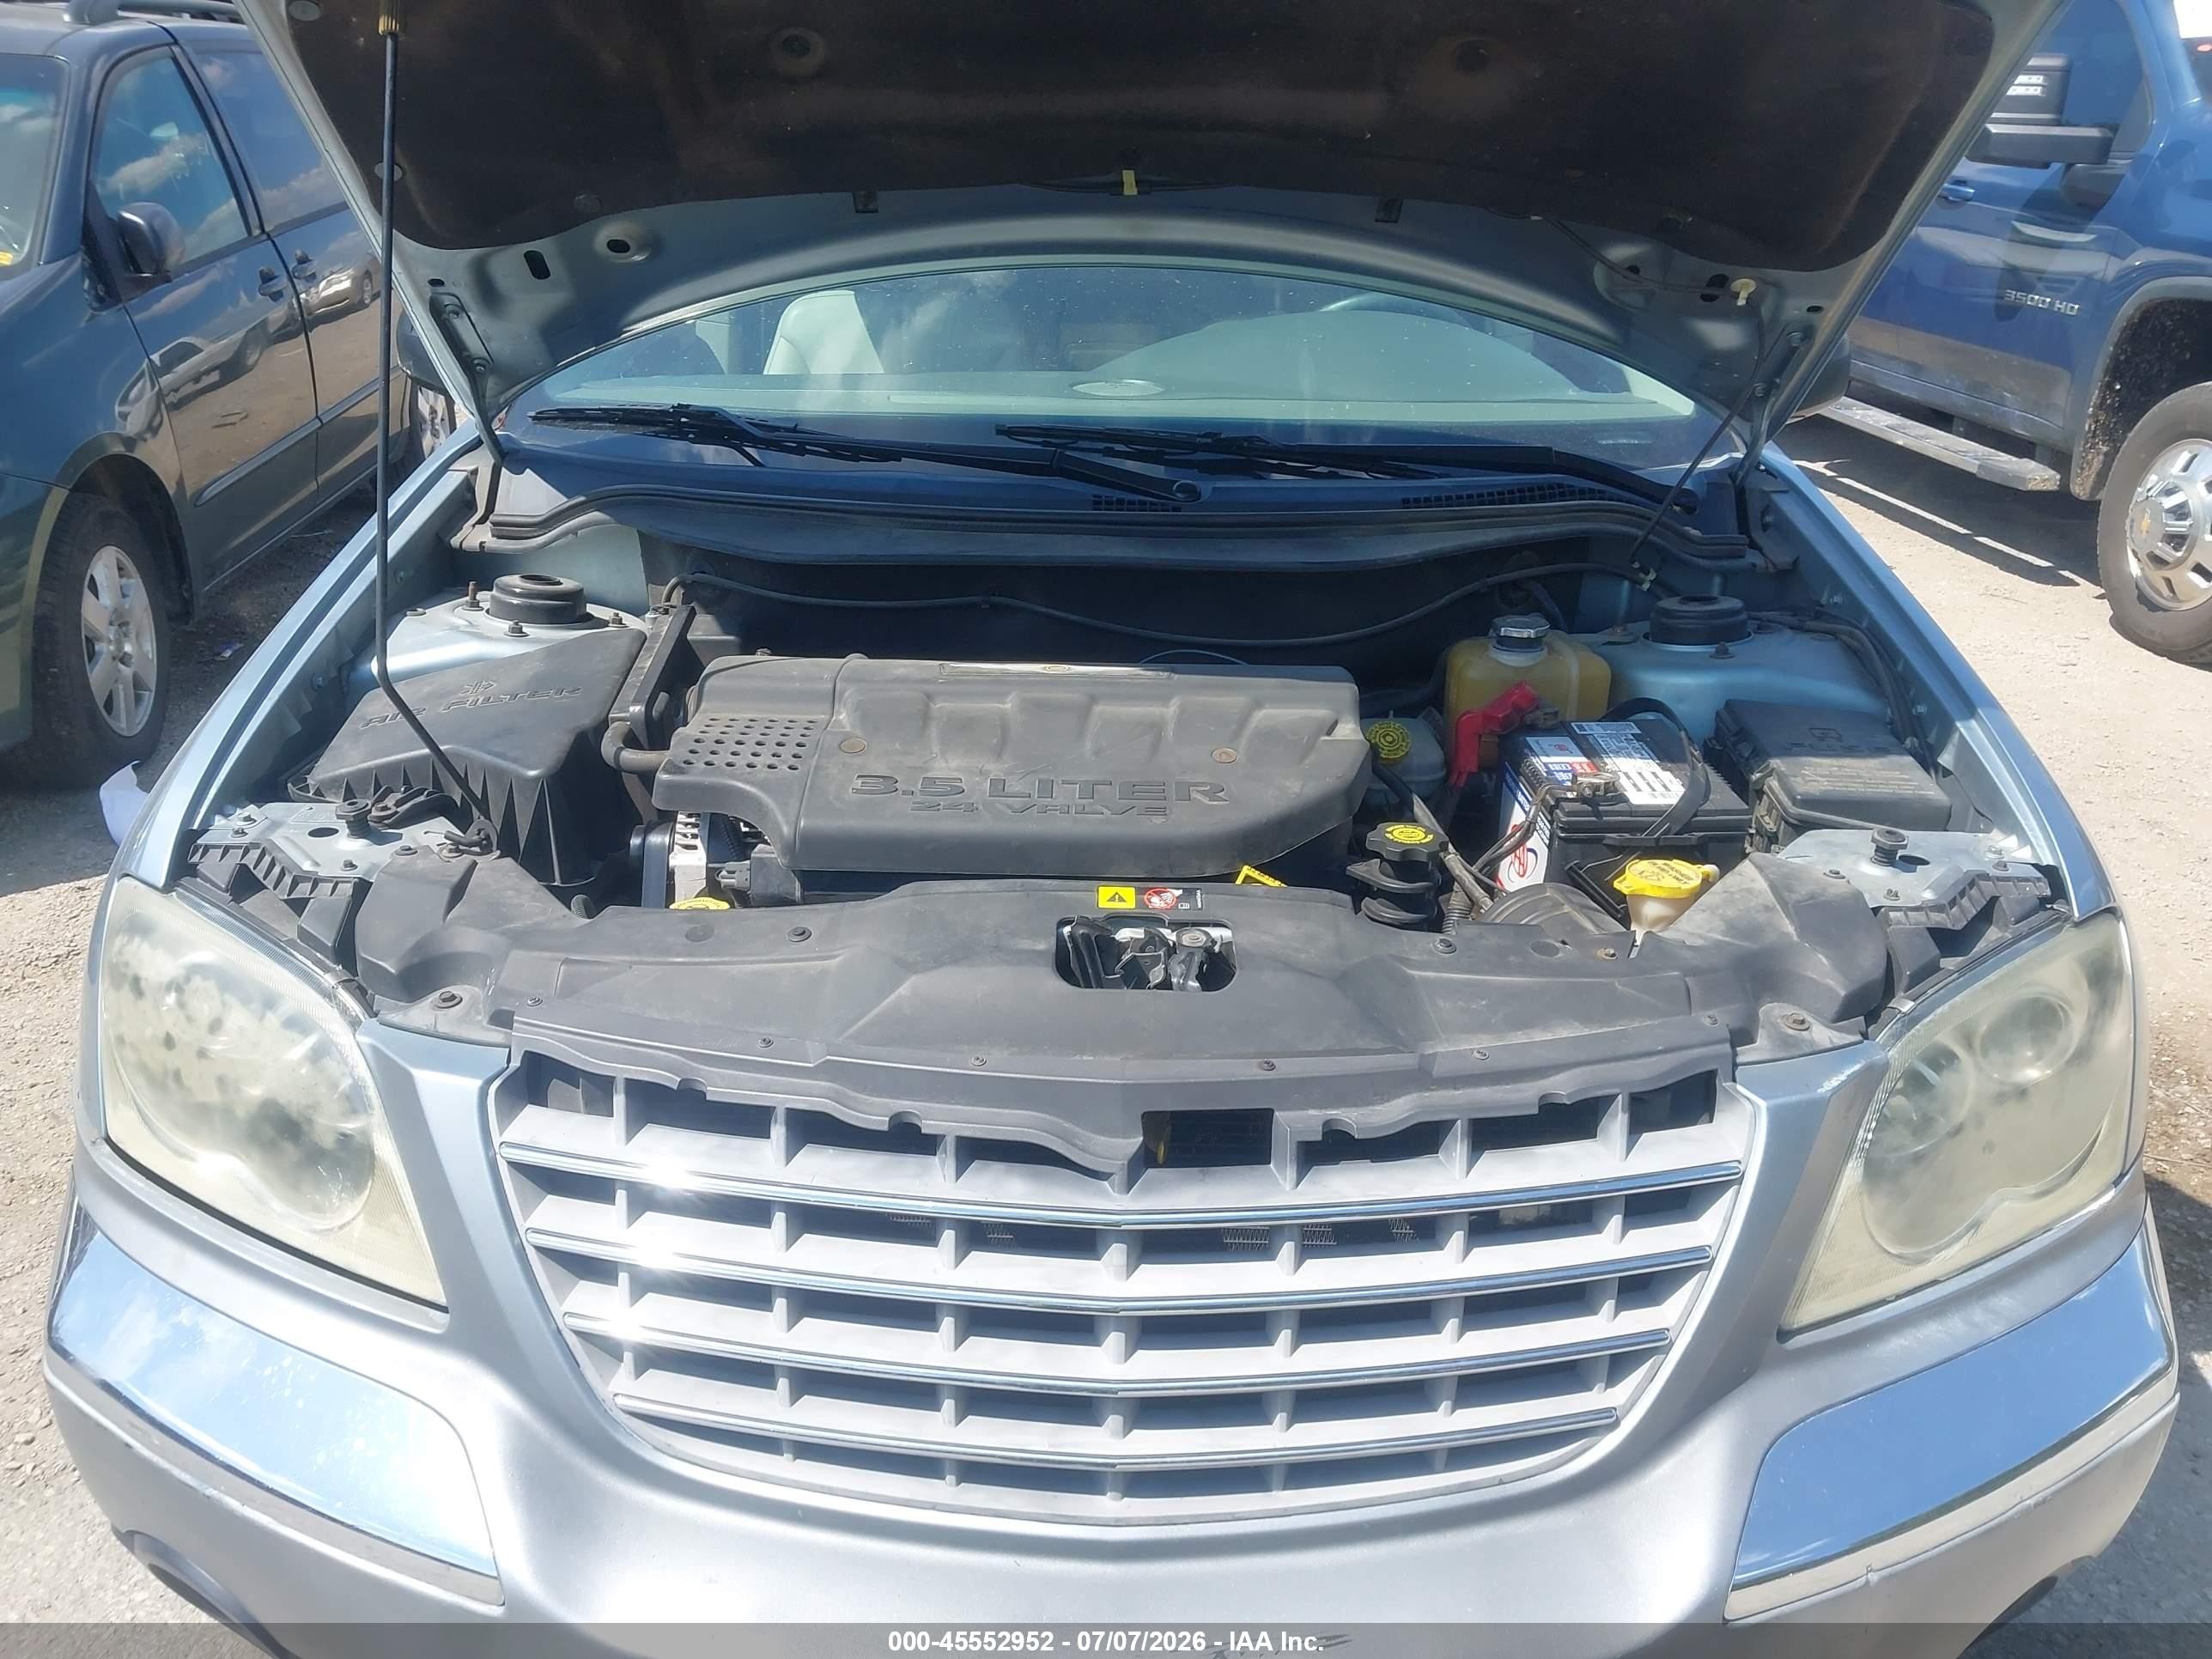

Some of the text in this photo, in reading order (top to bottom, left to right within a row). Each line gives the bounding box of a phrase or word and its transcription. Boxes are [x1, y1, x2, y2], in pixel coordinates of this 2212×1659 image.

[2004, 289, 2080, 315] 3500 HD
[440, 687, 582, 712] FILTER
[852, 775, 1230, 804] 3.5 LITER
[910, 801, 1168, 817] 24 VALVE
